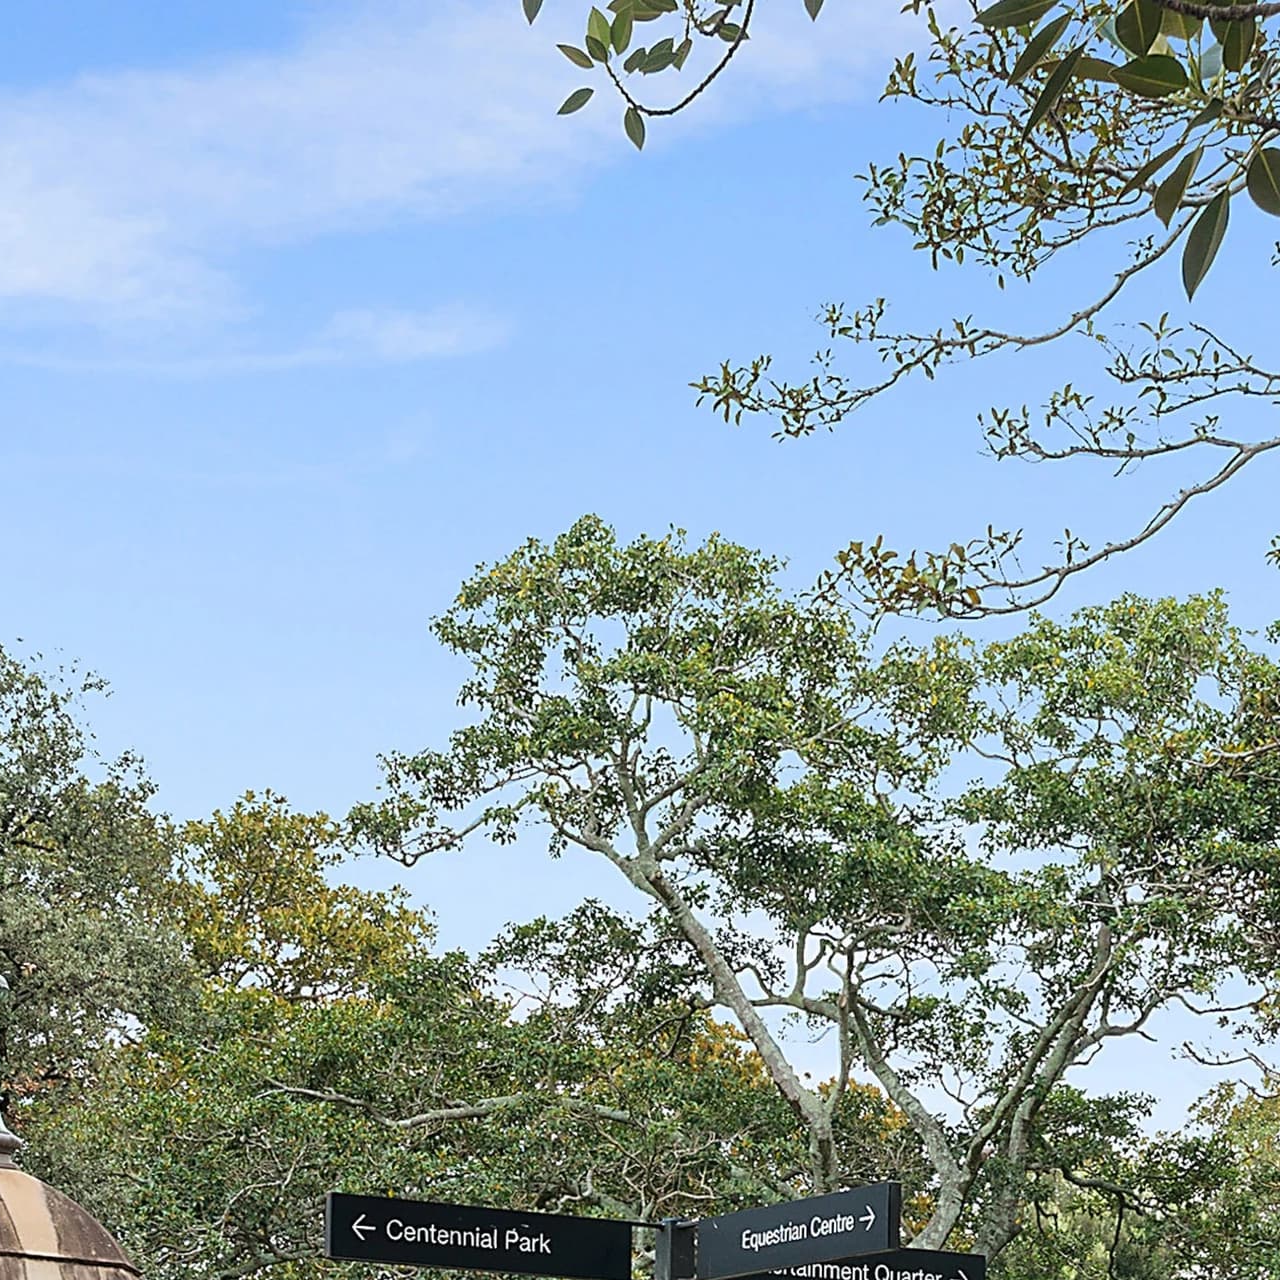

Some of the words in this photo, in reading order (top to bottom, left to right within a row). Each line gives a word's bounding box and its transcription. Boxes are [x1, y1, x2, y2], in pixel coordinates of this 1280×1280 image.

[386, 1219, 498, 1250] Centennial
[505, 1230, 552, 1254] Park
[741, 1221, 808, 1251] Equestrian
[810, 1214, 855, 1237] Centre
